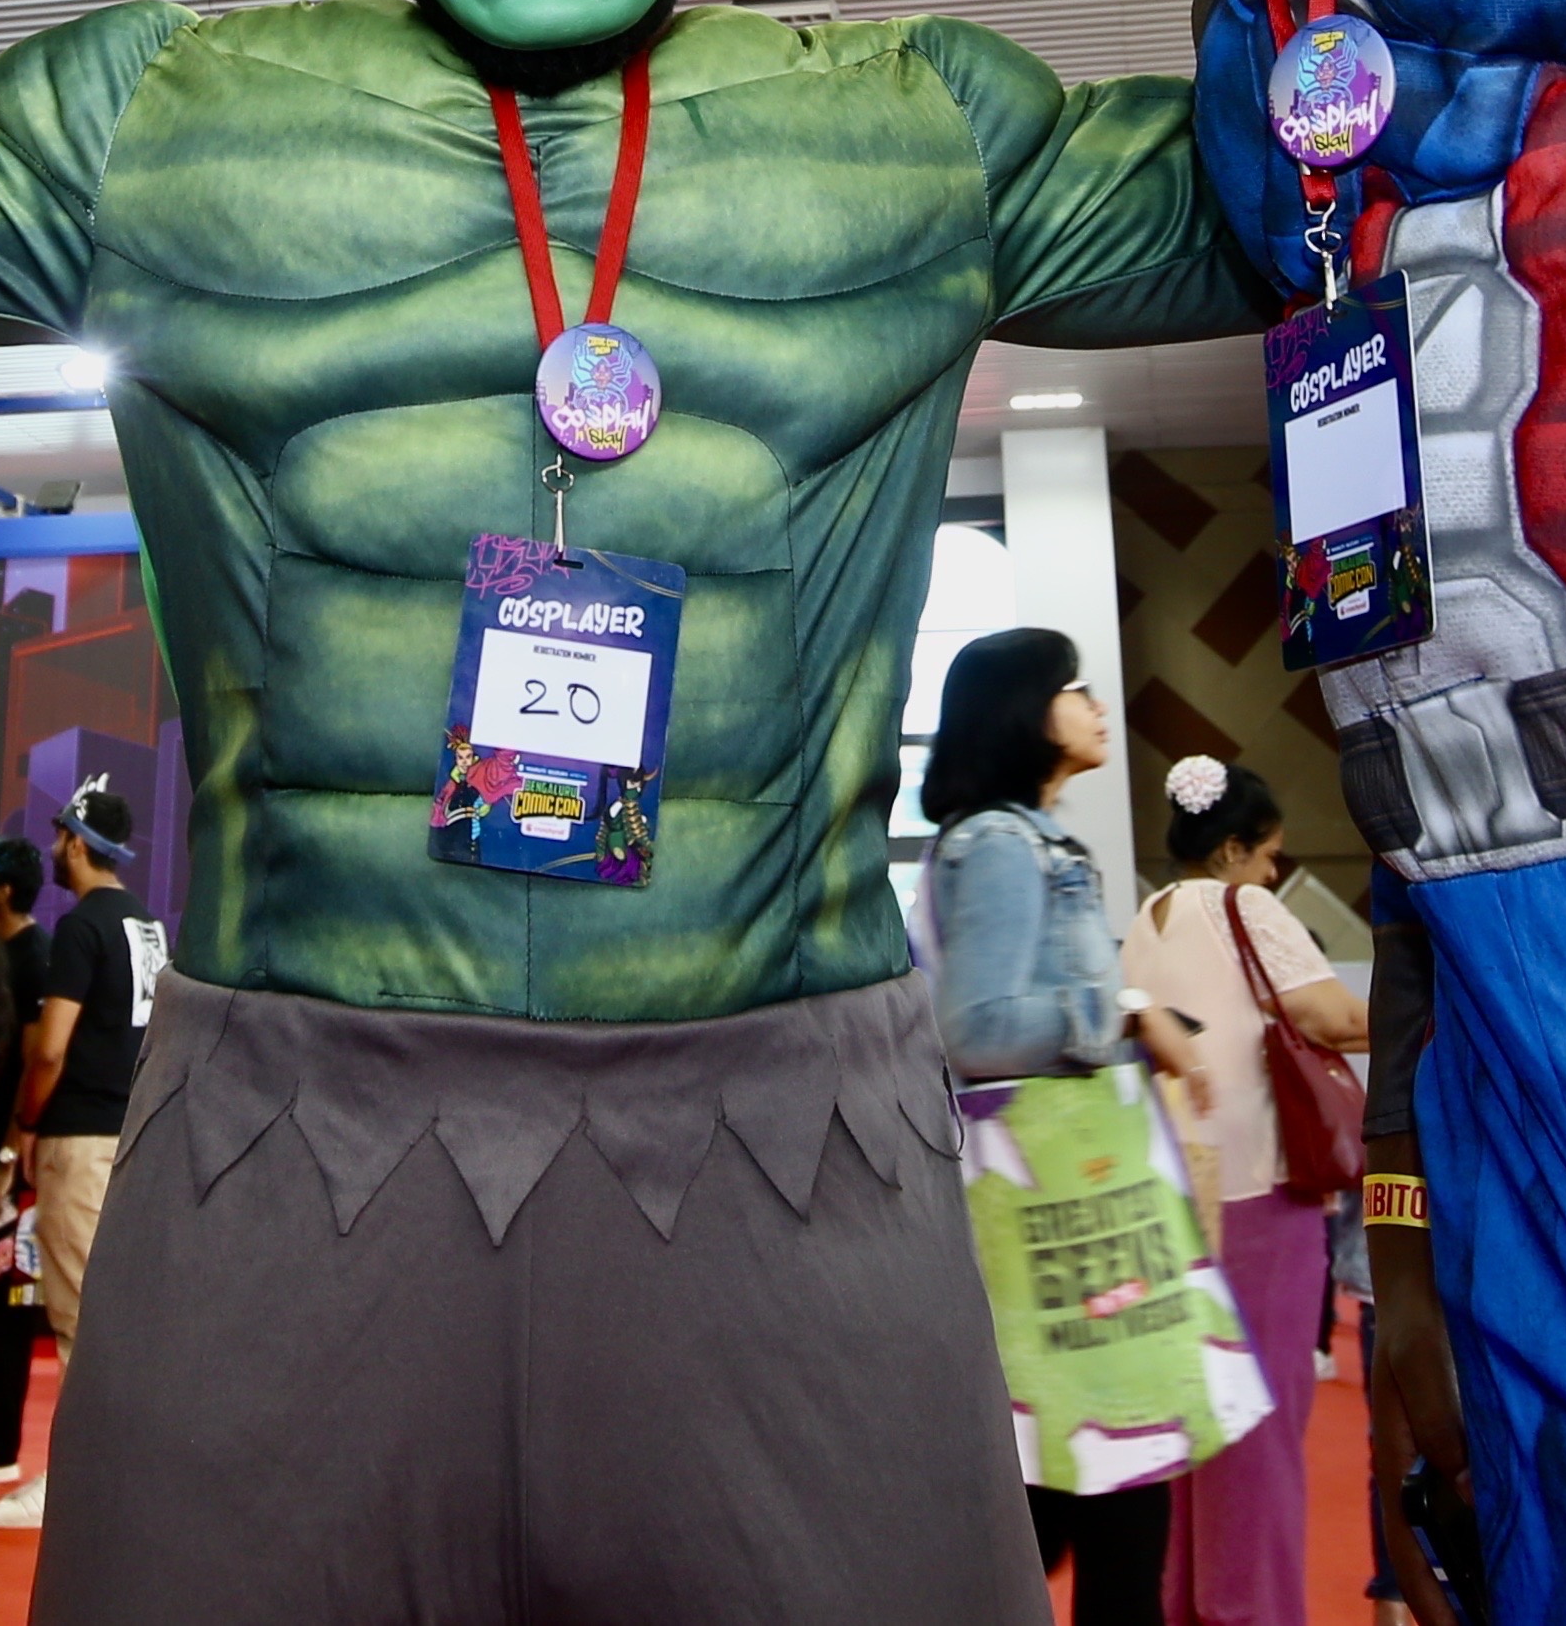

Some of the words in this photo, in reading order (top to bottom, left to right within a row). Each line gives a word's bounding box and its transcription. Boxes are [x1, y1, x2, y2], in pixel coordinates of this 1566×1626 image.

[1290, 332, 1387, 414] COSPLAYER
[498, 595, 645, 638] COSPLAYER
[519, 679, 601, 725] 20
[514, 790, 555, 817] COMIC
[555, 796, 581, 818] CON
